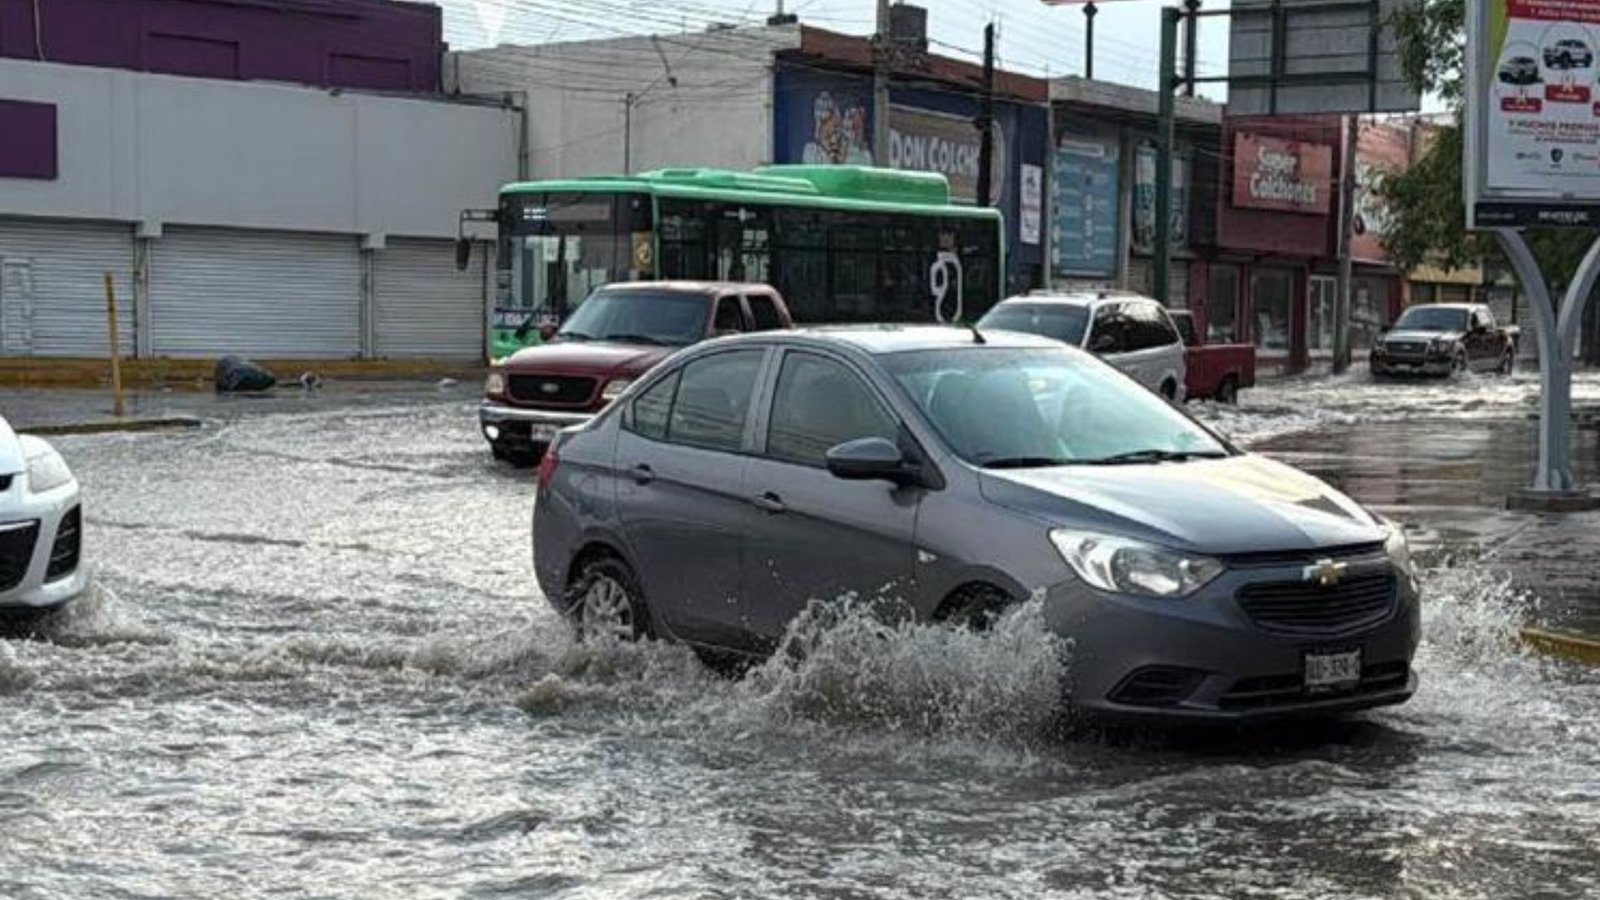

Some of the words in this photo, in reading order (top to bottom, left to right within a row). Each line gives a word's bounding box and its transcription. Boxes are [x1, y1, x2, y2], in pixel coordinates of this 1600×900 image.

[928, 136, 981, 177] COLCH
[1258, 146, 1297, 178] Super
[1249, 172, 1316, 203] Colchones
